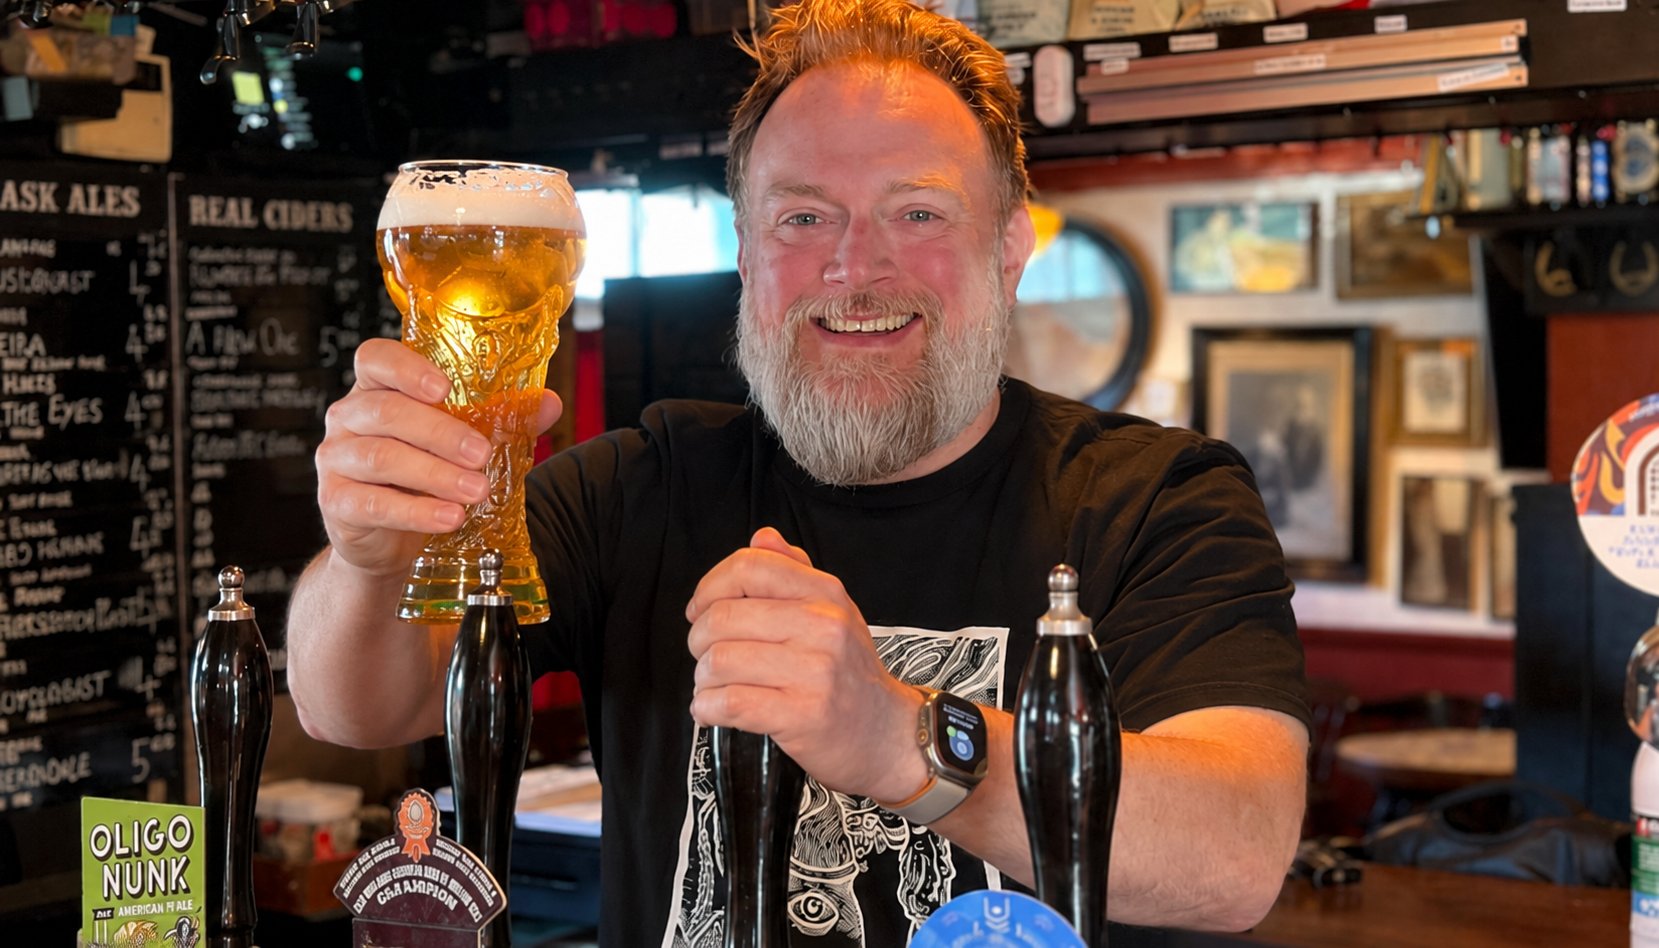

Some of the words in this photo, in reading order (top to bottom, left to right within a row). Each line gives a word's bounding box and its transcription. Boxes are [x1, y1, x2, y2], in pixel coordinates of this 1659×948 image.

[66, 183, 141, 219] ALES
[188, 194, 259, 229] REAL
[263, 197, 353, 234] CIDERS
[90, 814, 194, 861] OLIGO
[102, 855, 190, 901] NUNK
[118, 901, 164, 917] AMERICAN
